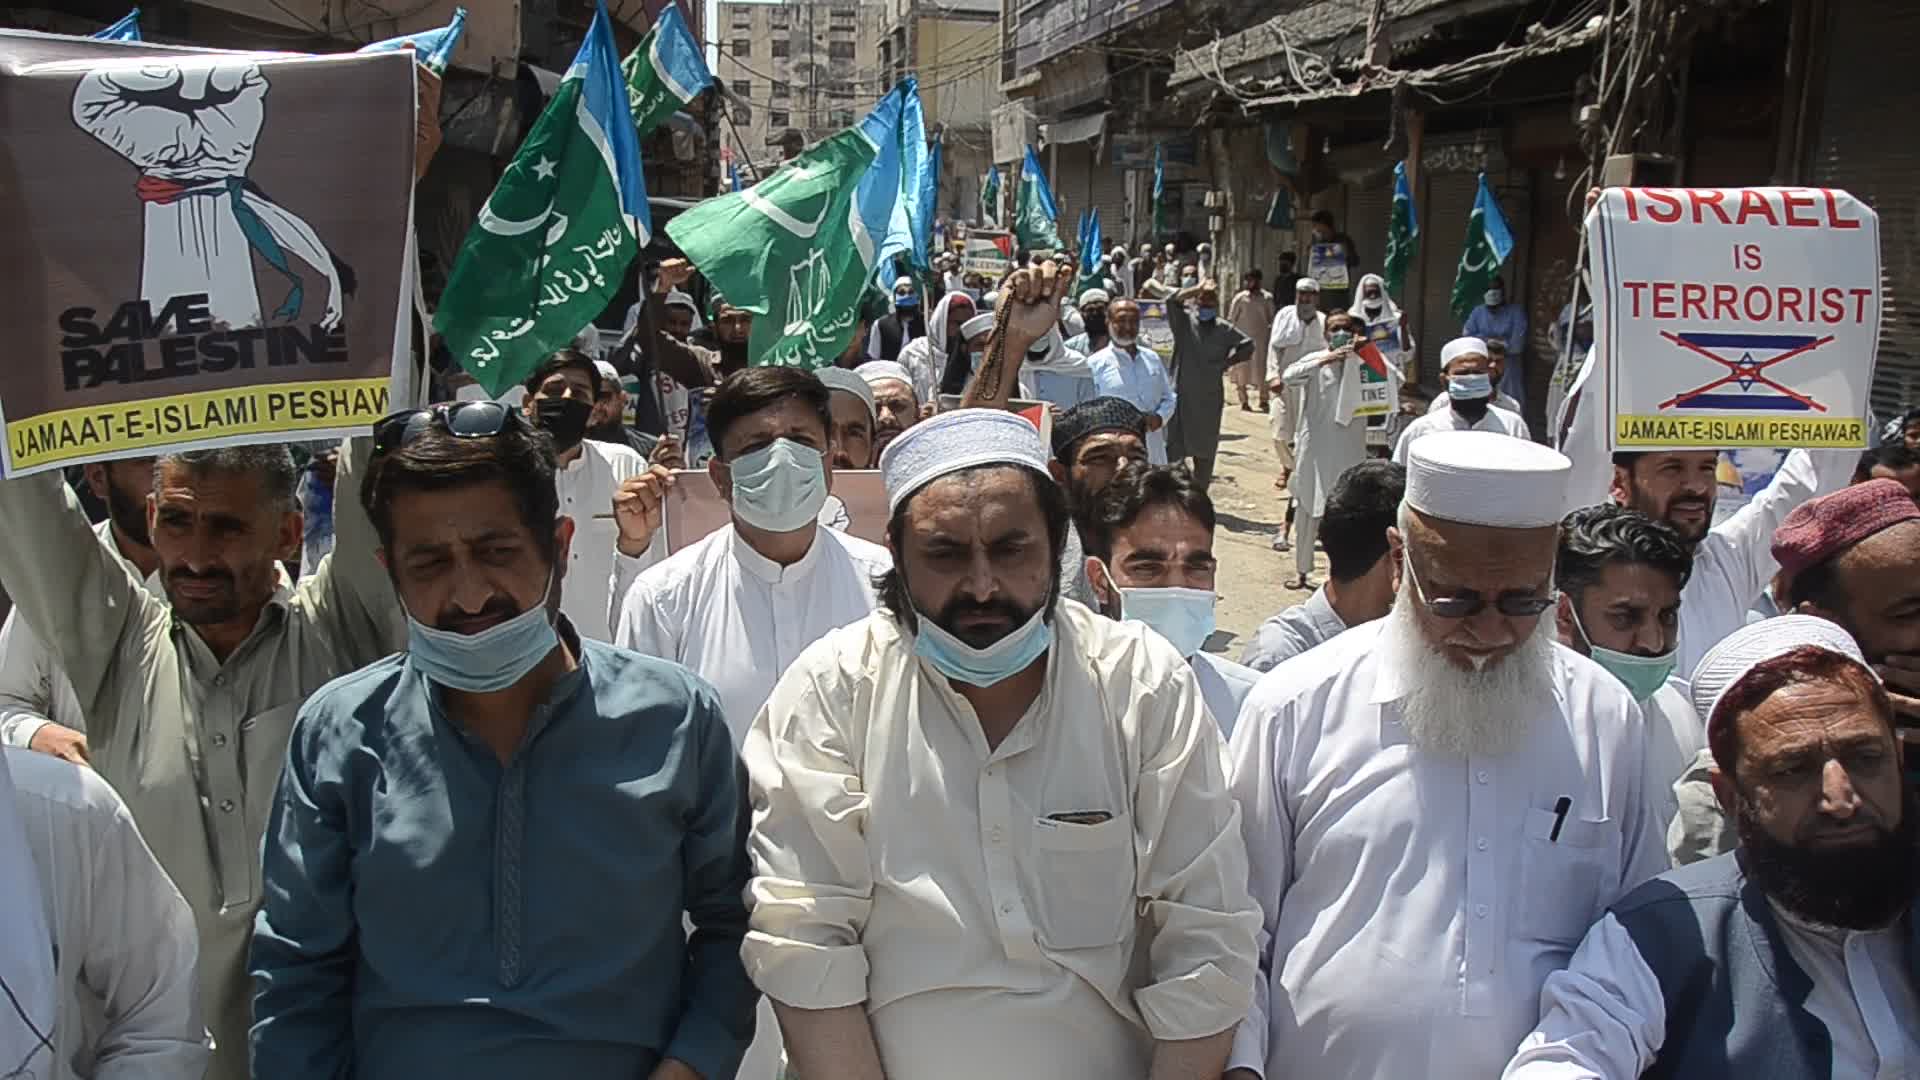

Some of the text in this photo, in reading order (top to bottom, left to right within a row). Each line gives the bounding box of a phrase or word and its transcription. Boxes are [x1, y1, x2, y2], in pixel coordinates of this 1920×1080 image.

[1621, 188, 1861, 229] ISRAEL
[1733, 244, 1762, 271] IS
[59, 293, 211, 347] SAVE
[1623, 282, 1872, 324] TERRORIST
[60, 324, 349, 392] PALESTINE
[15, 386, 391, 459] JAMAAT-E-ISLAMI PESHAW
[1620, 421, 1861, 441] JAMAAT-E-ISLAMI PESHAWAR
